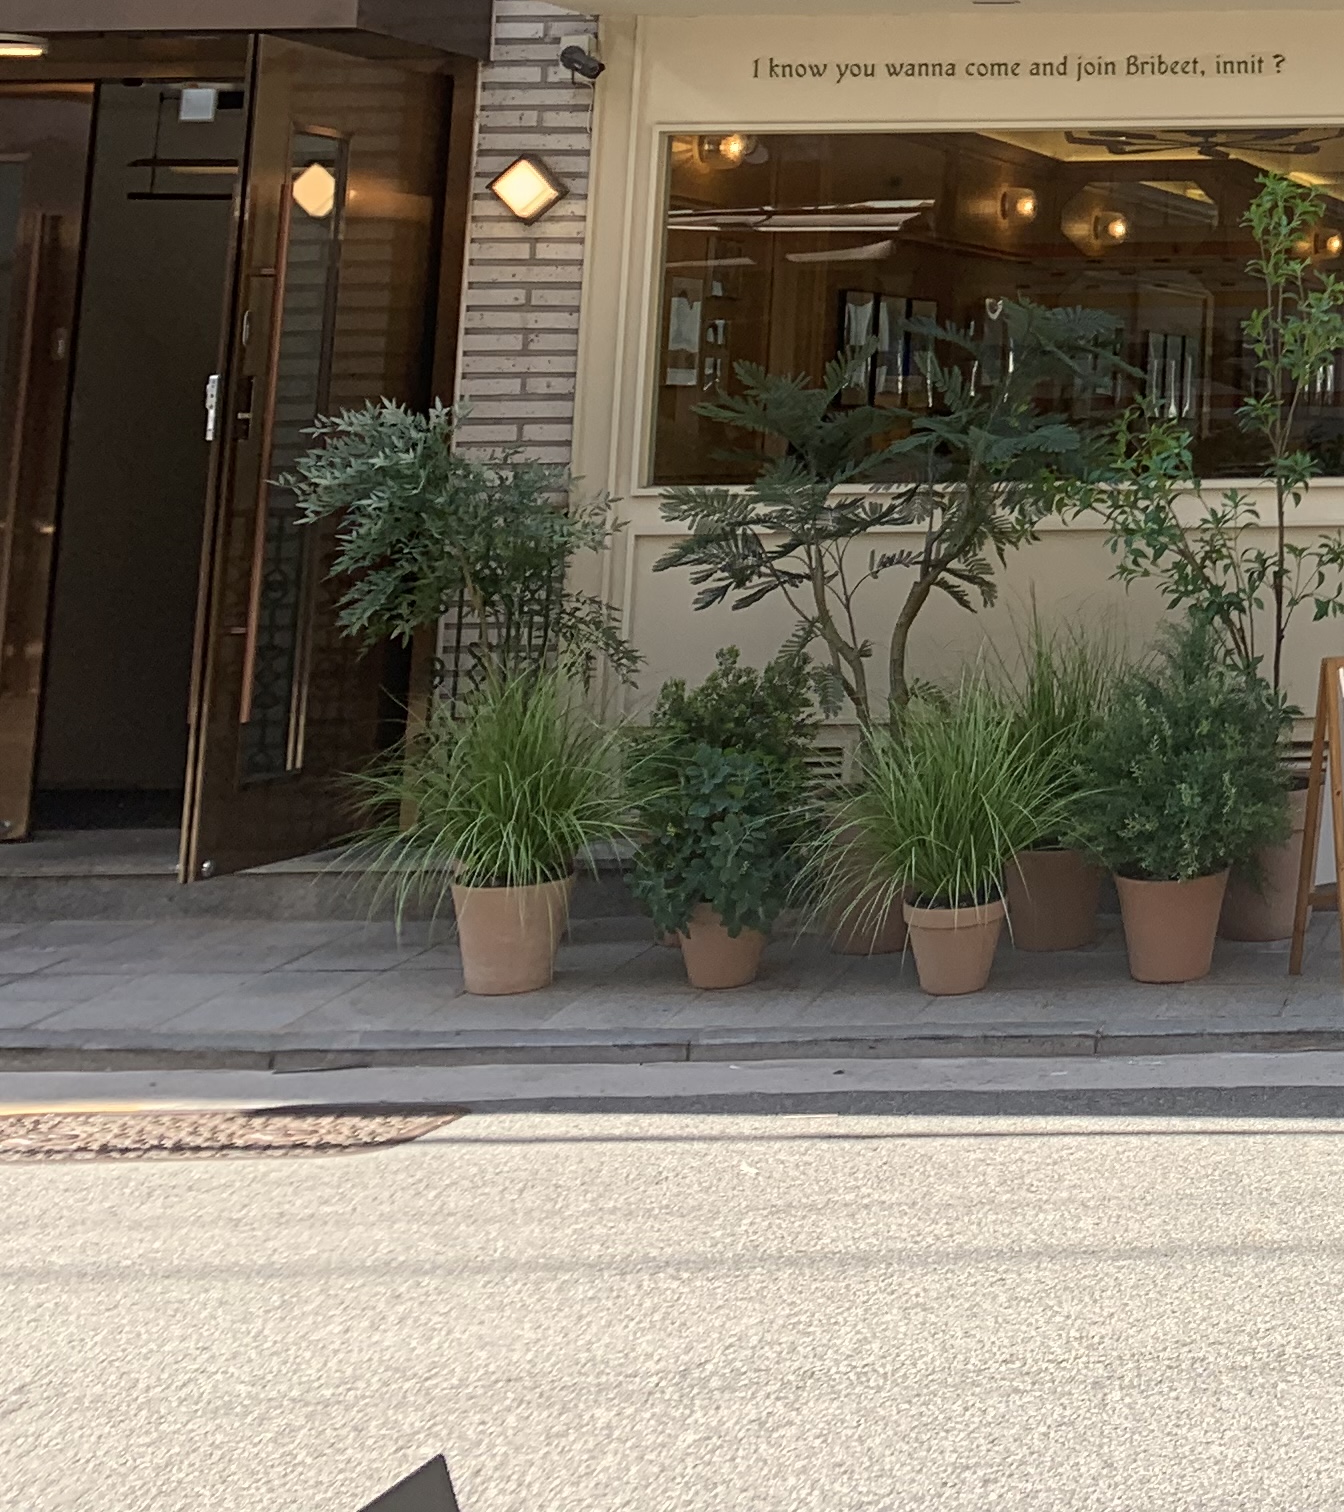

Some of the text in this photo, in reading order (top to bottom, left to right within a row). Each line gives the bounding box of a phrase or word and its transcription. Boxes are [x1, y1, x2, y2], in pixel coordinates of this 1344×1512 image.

[752, 57, 761, 79] I
[768, 57, 828, 79] know
[835, 62, 876, 85] you
[885, 61, 957, 78] wanna
[965, 60, 1021, 77] come
[1029, 55, 1069, 76] and
[1076, 55, 1117, 81] join
[1125, 54, 1206, 78] Bribeet,
[1215, 54, 1265, 75] innit
